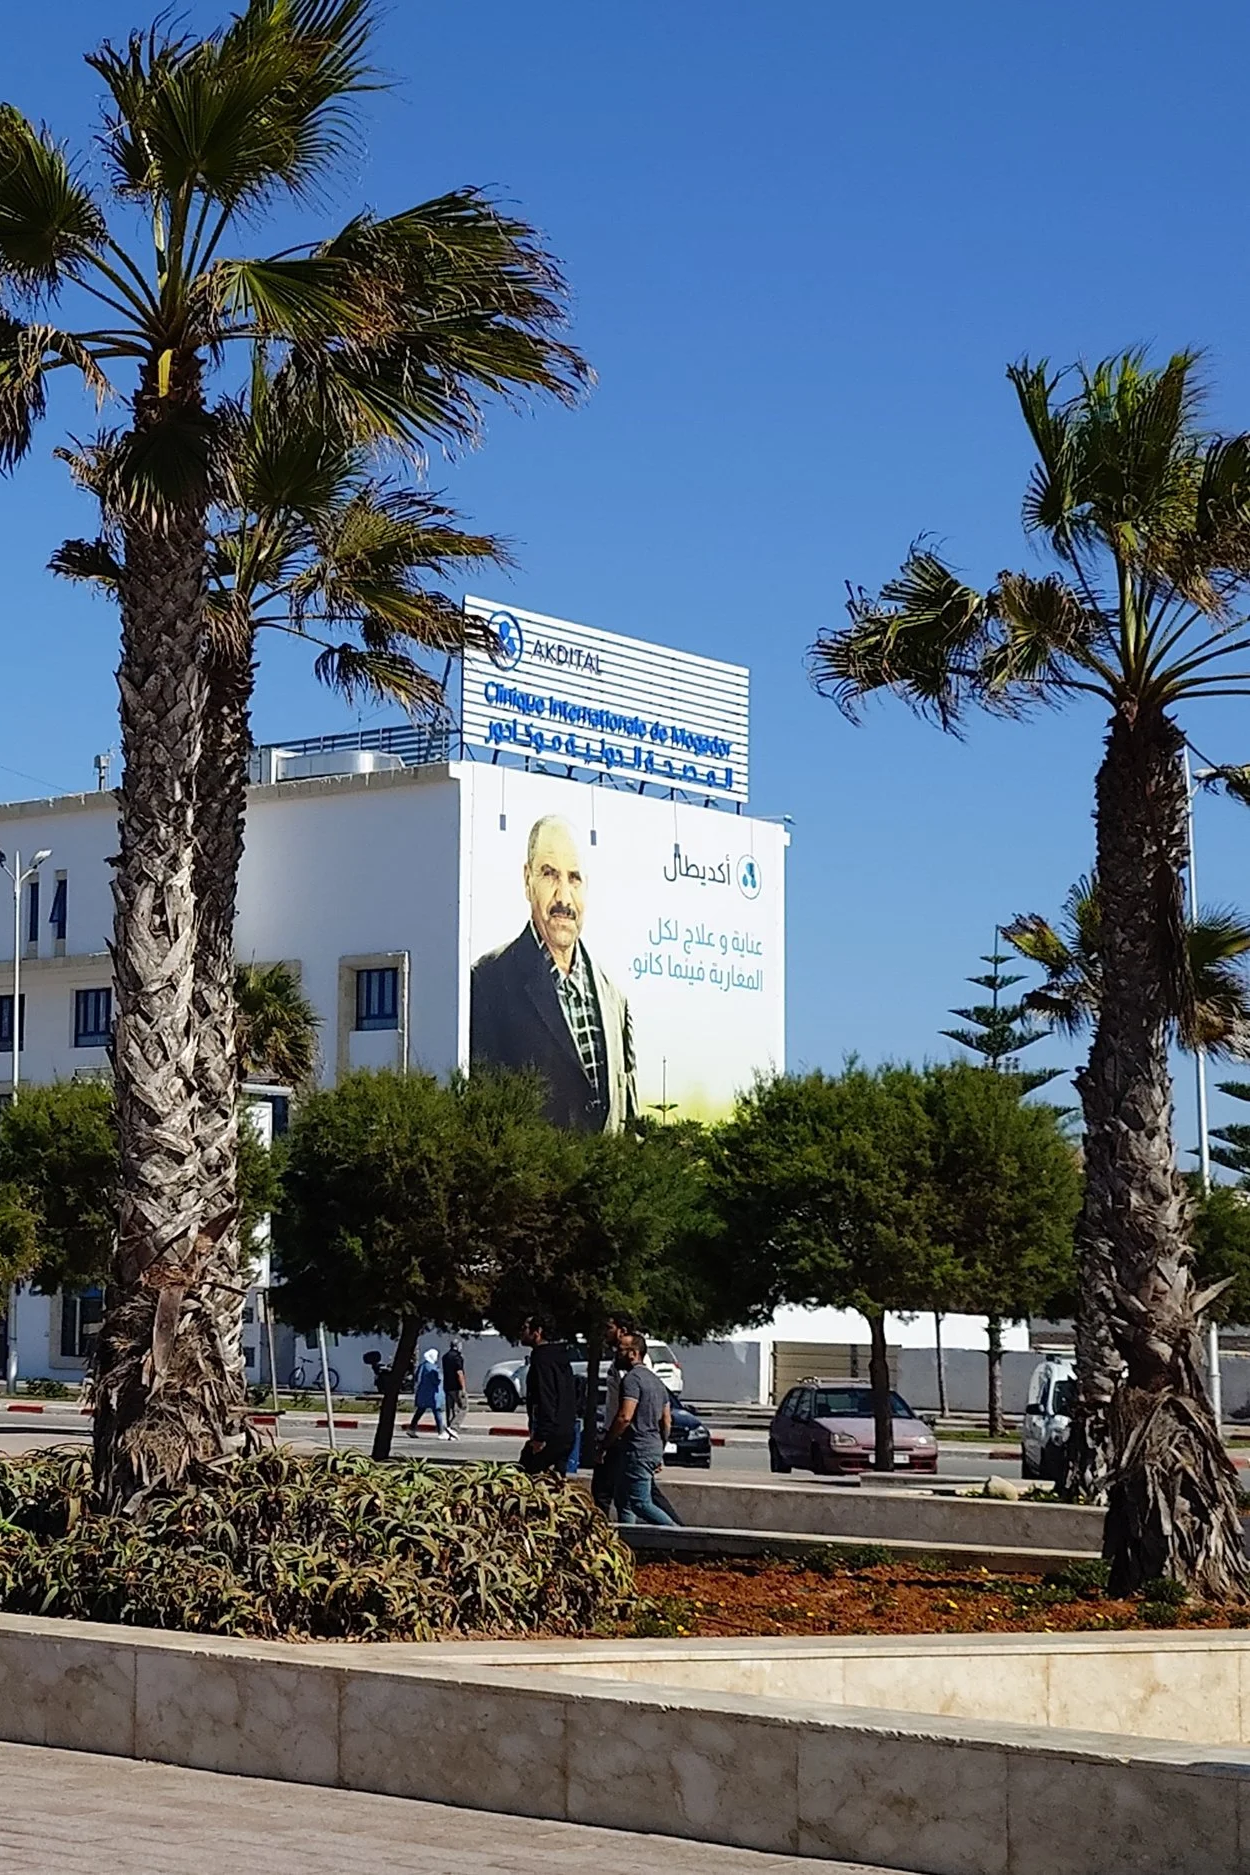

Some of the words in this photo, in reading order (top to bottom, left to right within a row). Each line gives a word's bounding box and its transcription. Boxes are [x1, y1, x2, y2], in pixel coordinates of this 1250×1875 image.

[531, 639, 602, 676] AKDITAL
[484, 681, 545, 716] Clinique
[549, 696, 646, 740] Internationale
[650, 721, 668, 745] de
[670, 725, 732, 757] Mogador
[564, 733, 642, 769] الدولية
[644, 751, 733, 789] المصحة
[664, 852, 731, 886] أكديطال
[649, 917, 678, 945] لكل
[683, 923, 716, 954] علاج
[720, 934, 728, 956] و
[732, 930, 763, 958] عناية
[668, 954, 705, 986] فينما
[710, 961, 763, 992] المغاربة
